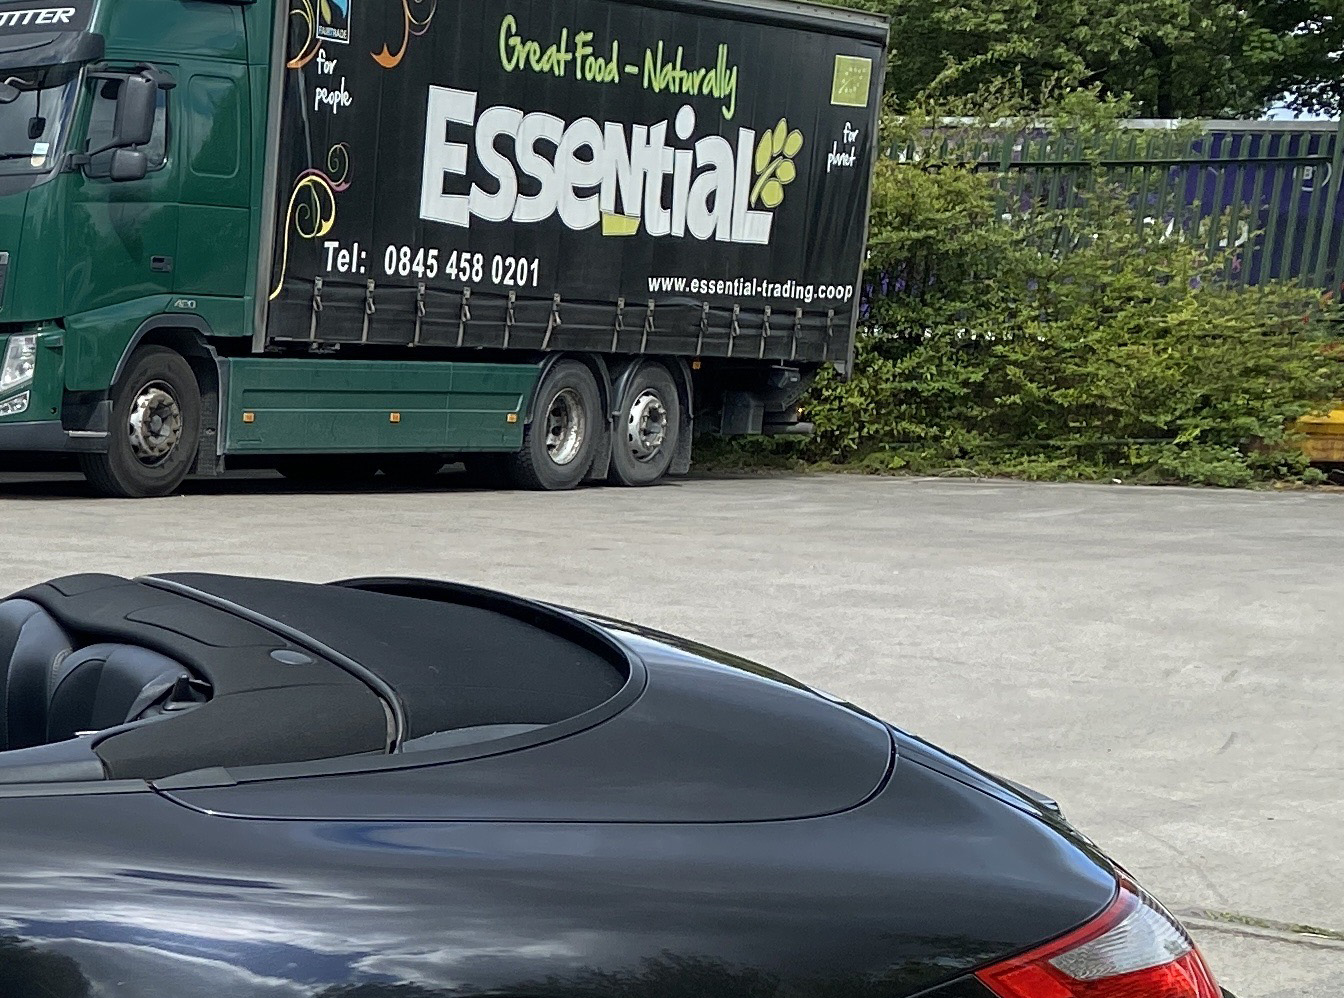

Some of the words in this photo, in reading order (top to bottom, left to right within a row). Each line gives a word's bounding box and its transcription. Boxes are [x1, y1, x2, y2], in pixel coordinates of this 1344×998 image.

[317, 48, 337, 75] for
[499, 14, 572, 77] Great
[575, 31, 620, 84] Food
[643, 40, 738, 120] Naturally
[315, 76, 352, 114] people
[843, 121, 859, 144] for
[827, 140, 857, 174] planet
[324, 241, 366, 275] Tel:
[384, 245, 438, 279] 0845
[445, 251, 483, 283] 458
[492, 254, 539, 287] 0201
[648, 277, 853, 303] www.essential-trading.coop
